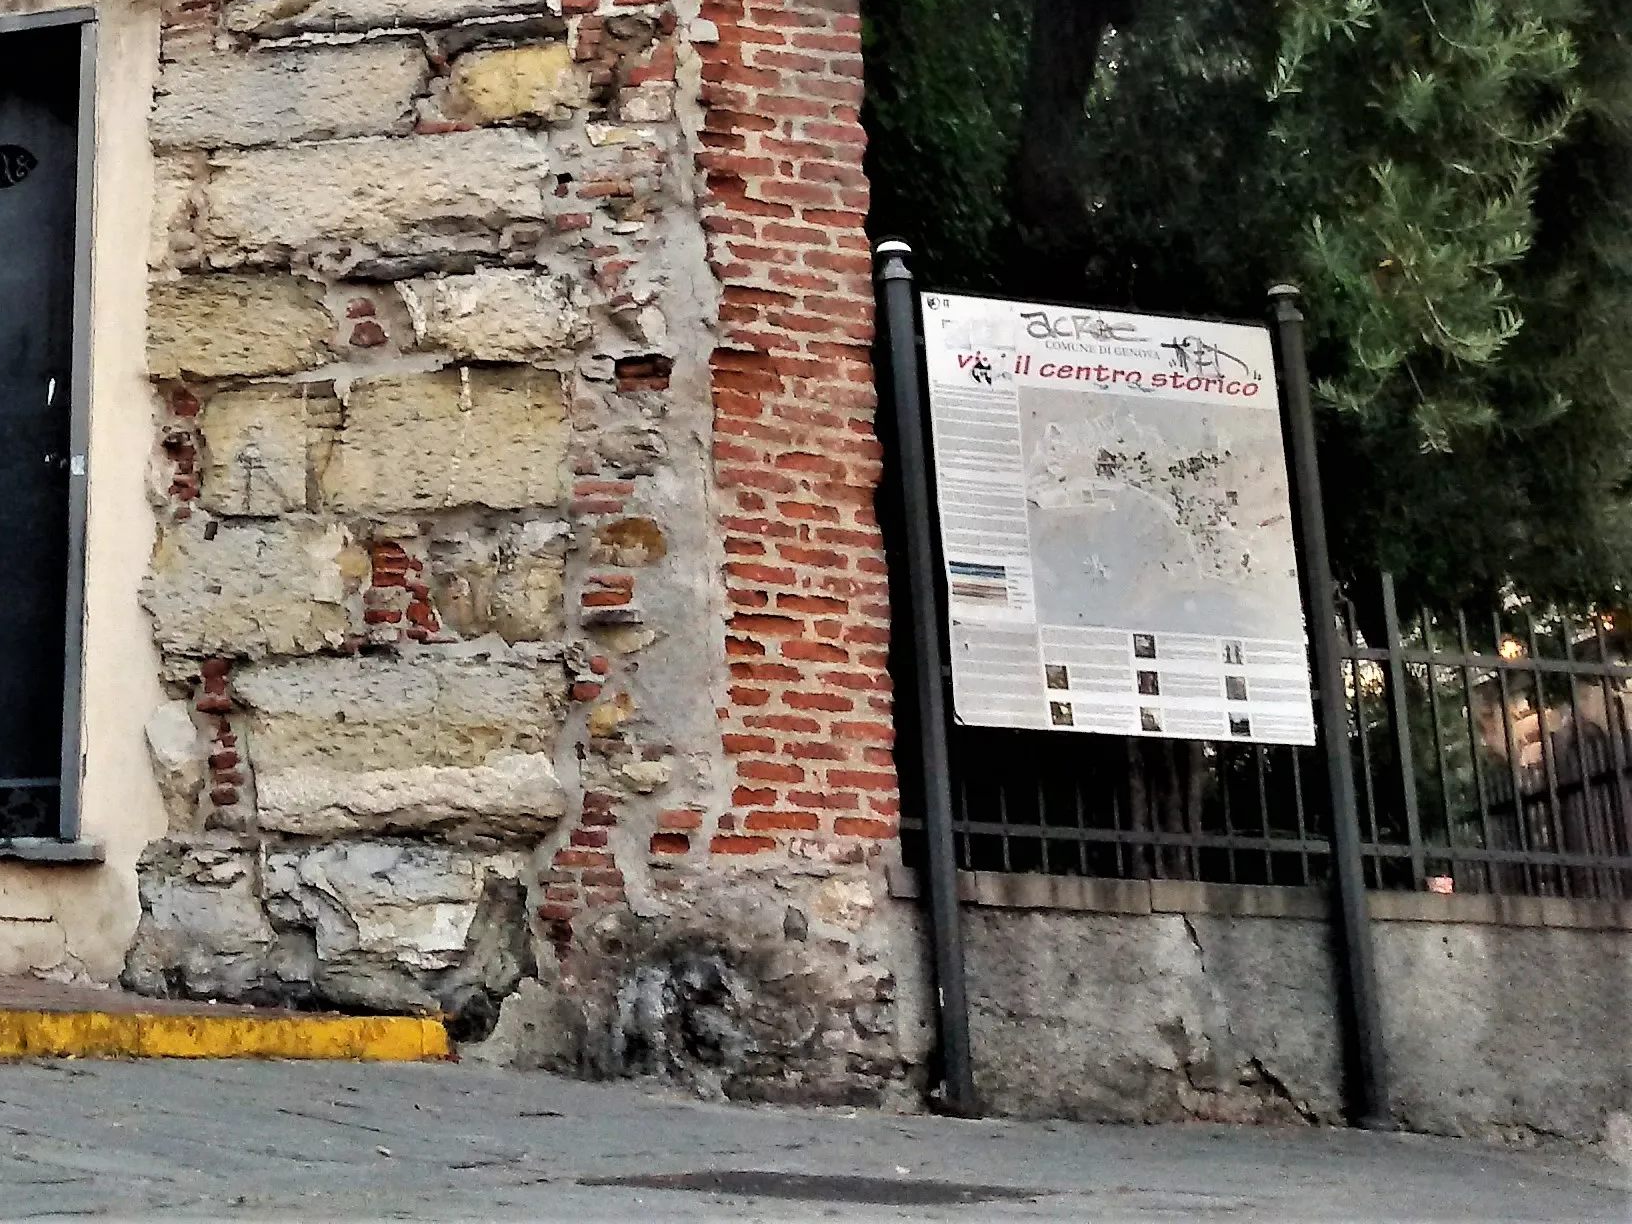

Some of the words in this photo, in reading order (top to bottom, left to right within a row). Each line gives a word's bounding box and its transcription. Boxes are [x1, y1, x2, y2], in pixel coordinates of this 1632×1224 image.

[1013, 355, 1032, 376] il
[1039, 363, 1142, 383] centro
[1151, 371, 1260, 396] storico
